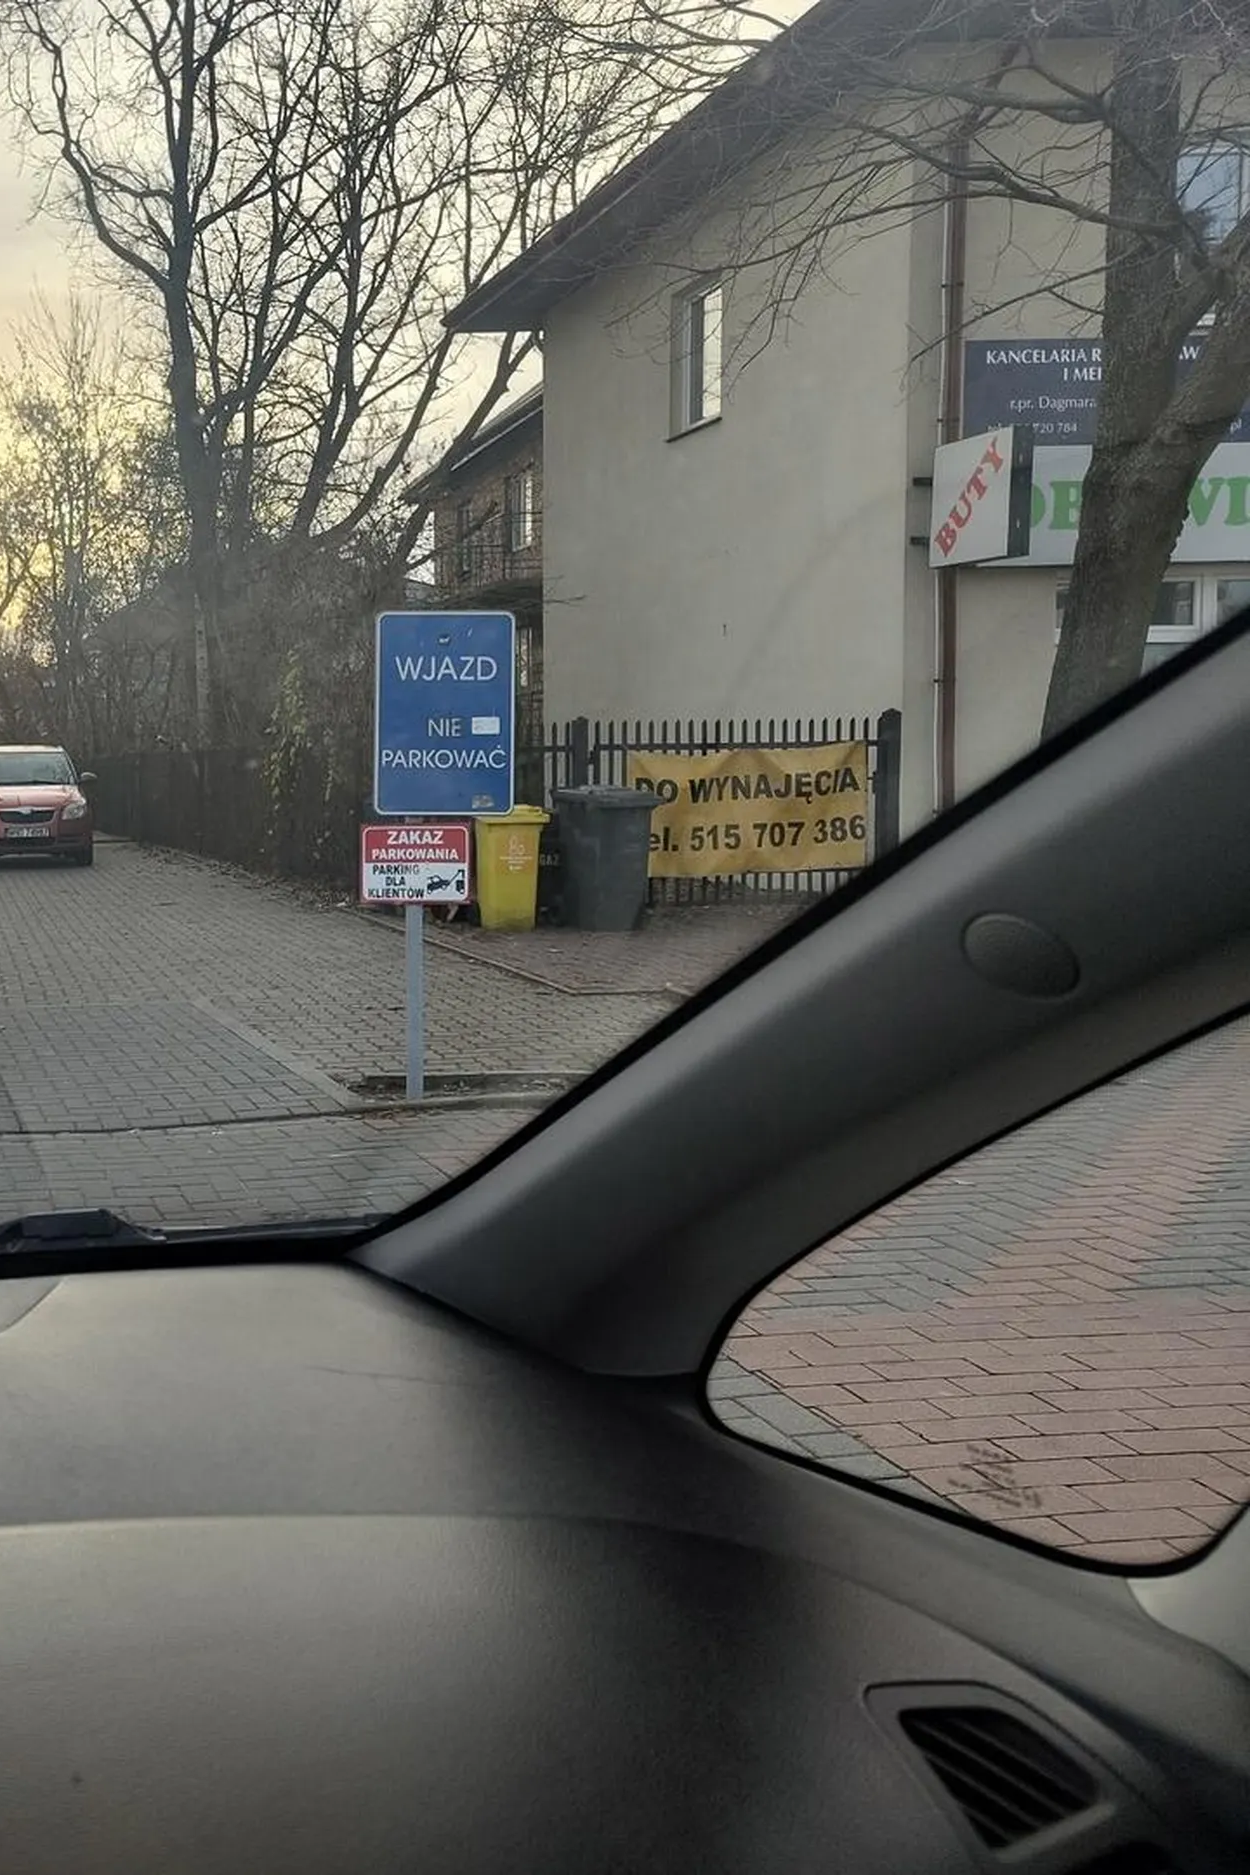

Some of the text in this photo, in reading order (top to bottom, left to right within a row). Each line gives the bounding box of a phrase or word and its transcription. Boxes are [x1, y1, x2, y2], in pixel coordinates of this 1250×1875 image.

[986, 348, 1088, 364] KANCELARIA
[934, 436, 1004, 558] BUTY
[395, 655, 498, 681] WJAZD
[428, 717, 463, 737] NIE
[688, 767, 860, 804] WYNAJĘCIA
[387, 830, 445, 845] ZAKAZ
[649, 814, 866, 852] el. 515 707 386
[371, 847, 459, 860] PARKOWANIA
[372, 863, 420, 875] PARKING
[385, 876, 406, 887] DLA
